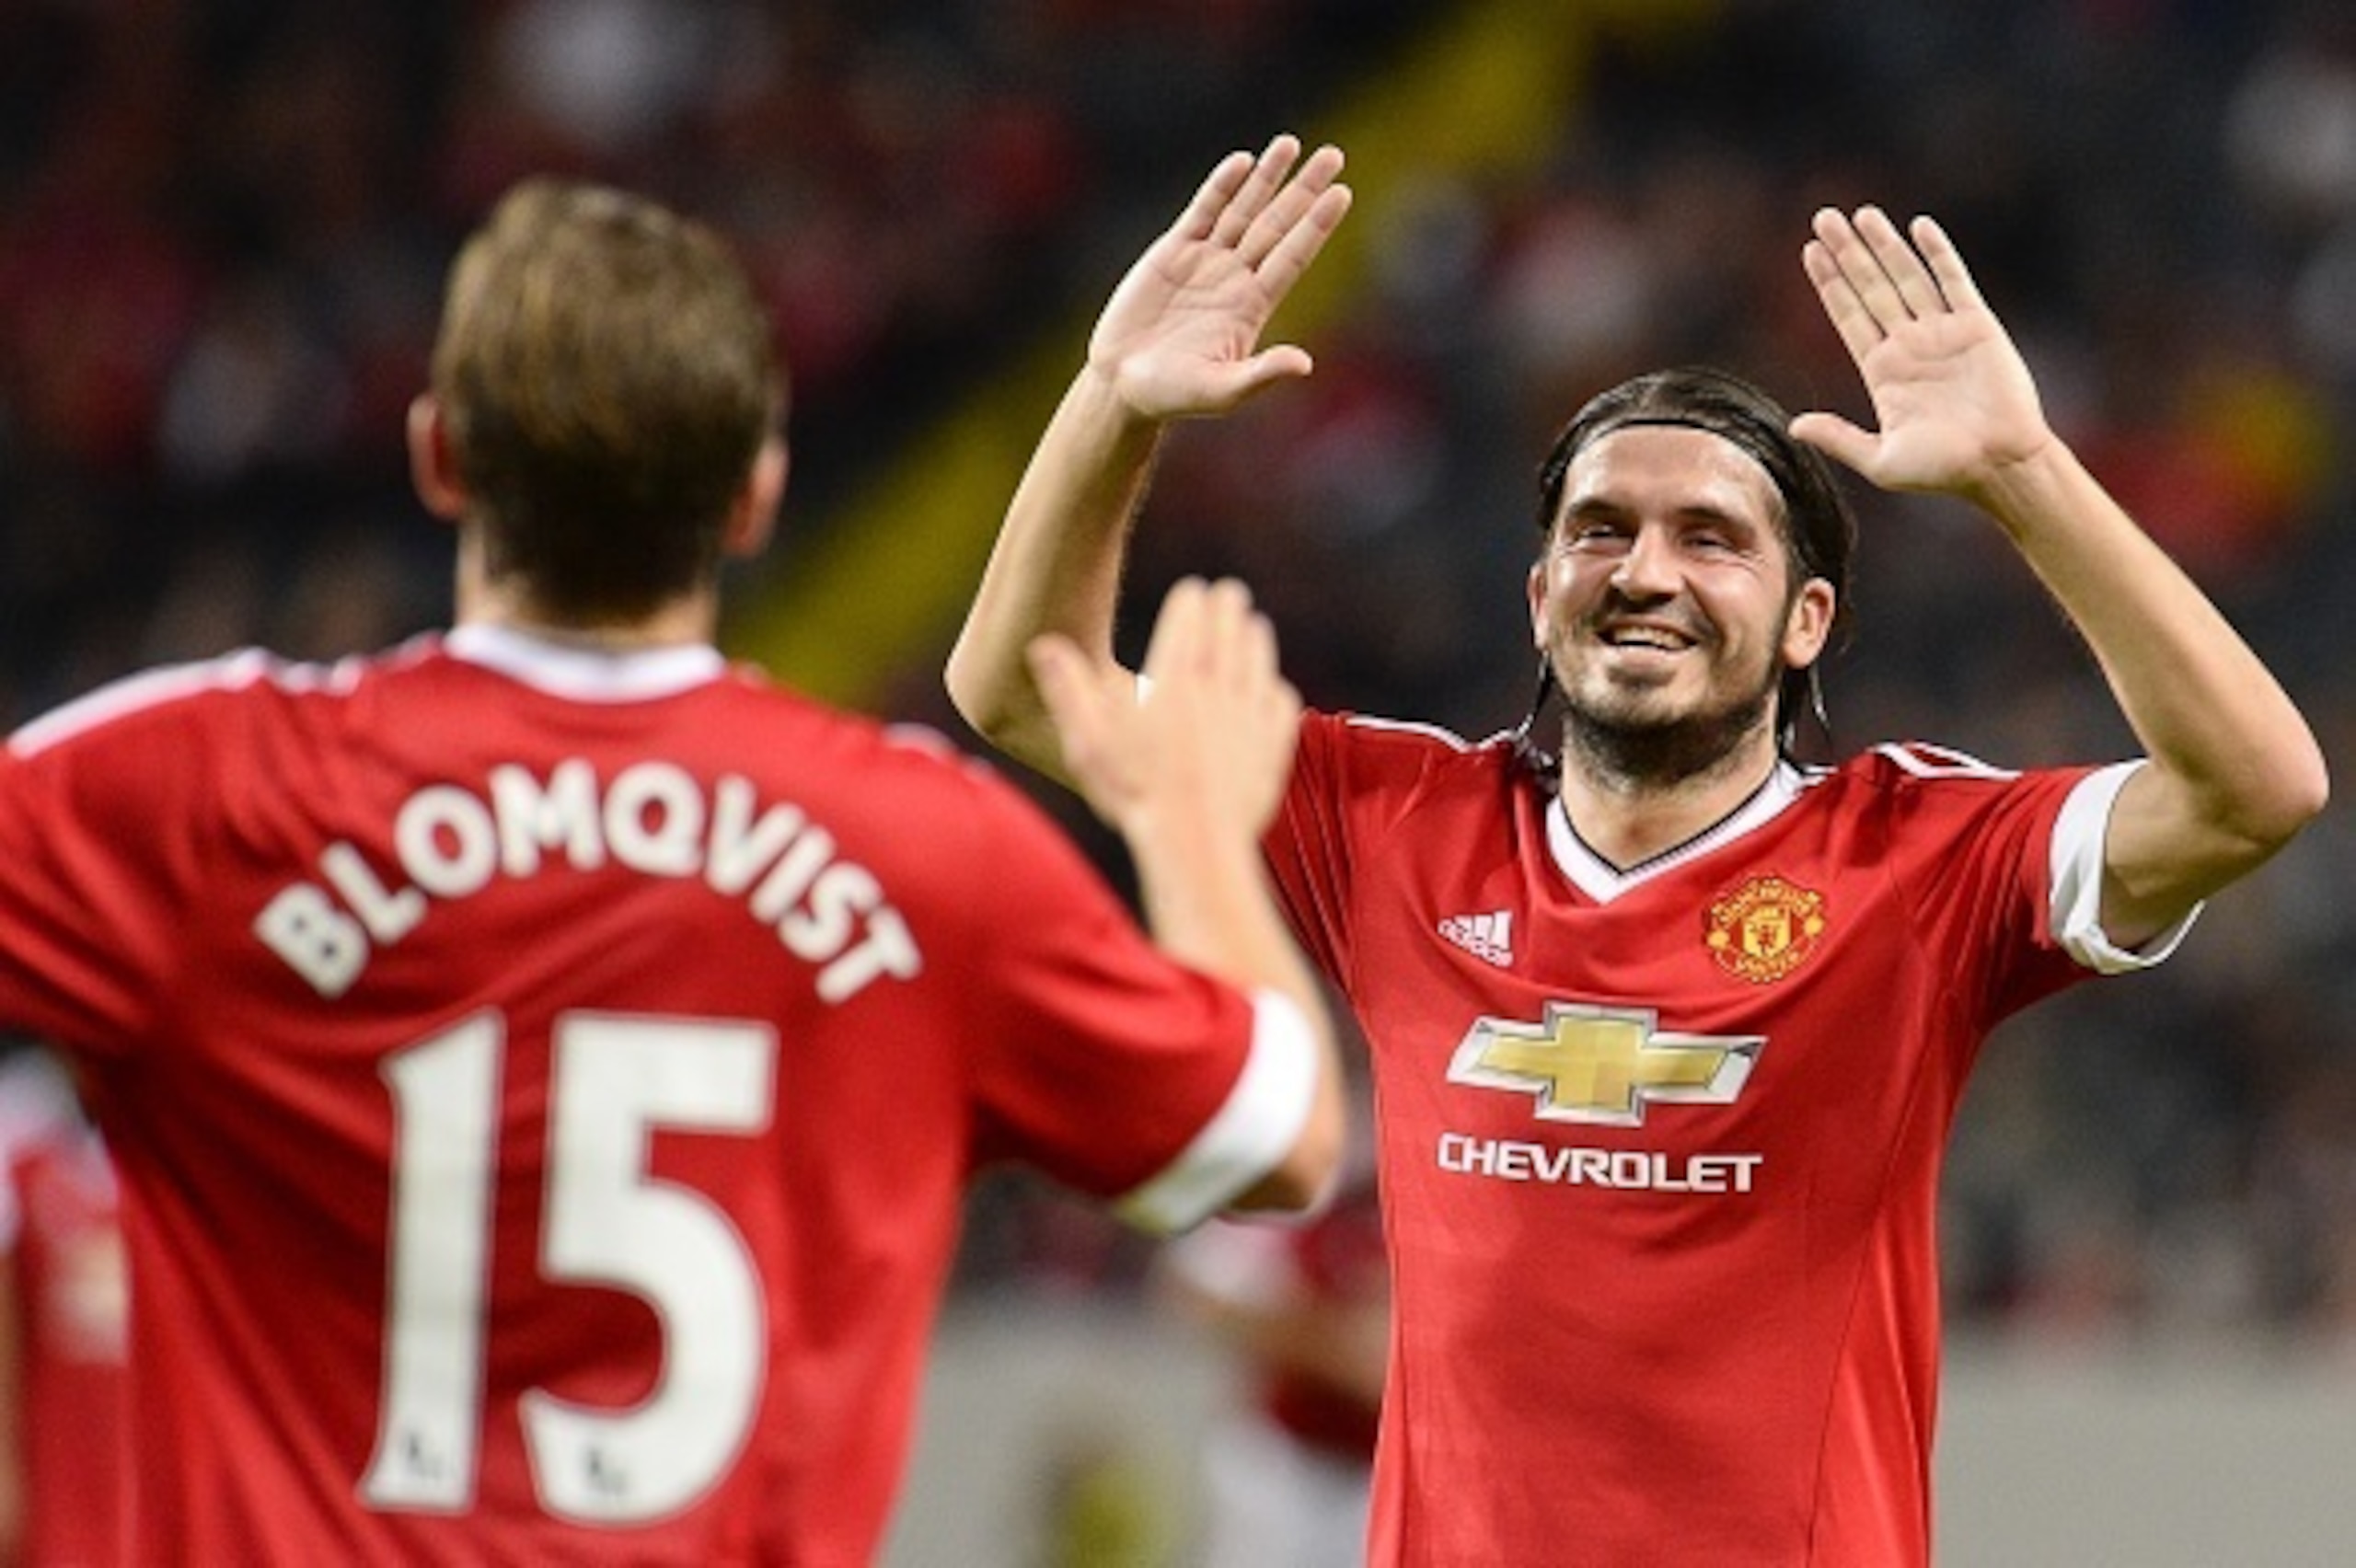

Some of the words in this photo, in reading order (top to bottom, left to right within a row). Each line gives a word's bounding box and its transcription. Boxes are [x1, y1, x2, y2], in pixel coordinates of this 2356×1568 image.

[253, 757, 921, 1002] BLOMQVIST
[355, 1007, 780, 1525] 15
[1437, 1131, 1763, 1193] CHEVROLET
